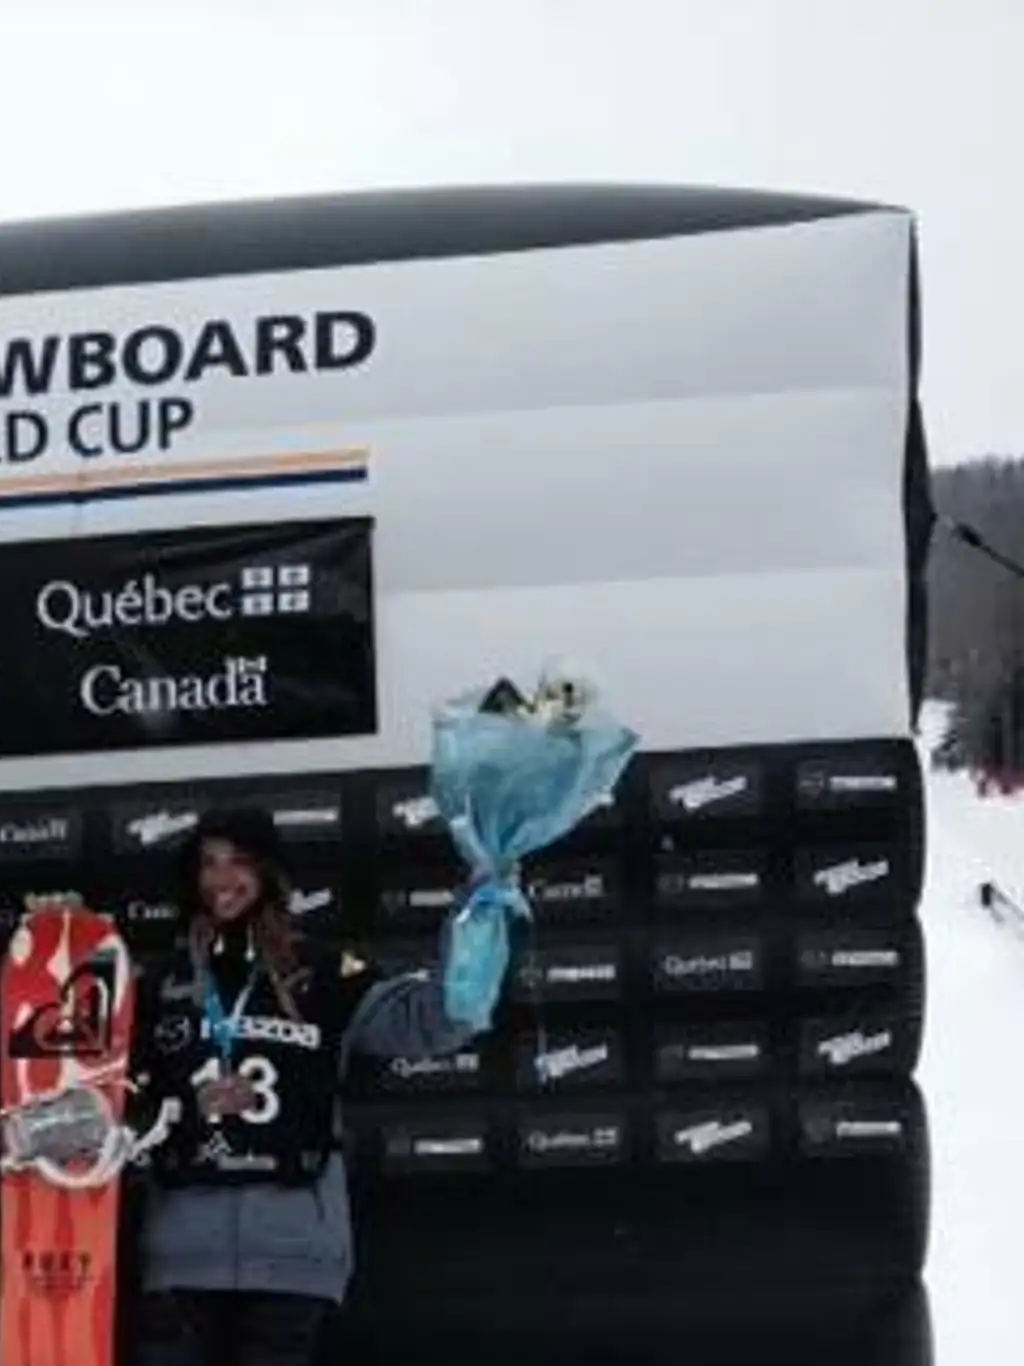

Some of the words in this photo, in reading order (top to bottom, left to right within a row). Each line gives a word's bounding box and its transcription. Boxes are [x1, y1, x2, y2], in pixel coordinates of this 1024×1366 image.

[67, 396, 194, 457] CUP
[36, 573, 234, 637] Québec
[80, 657, 269, 715] Canada
